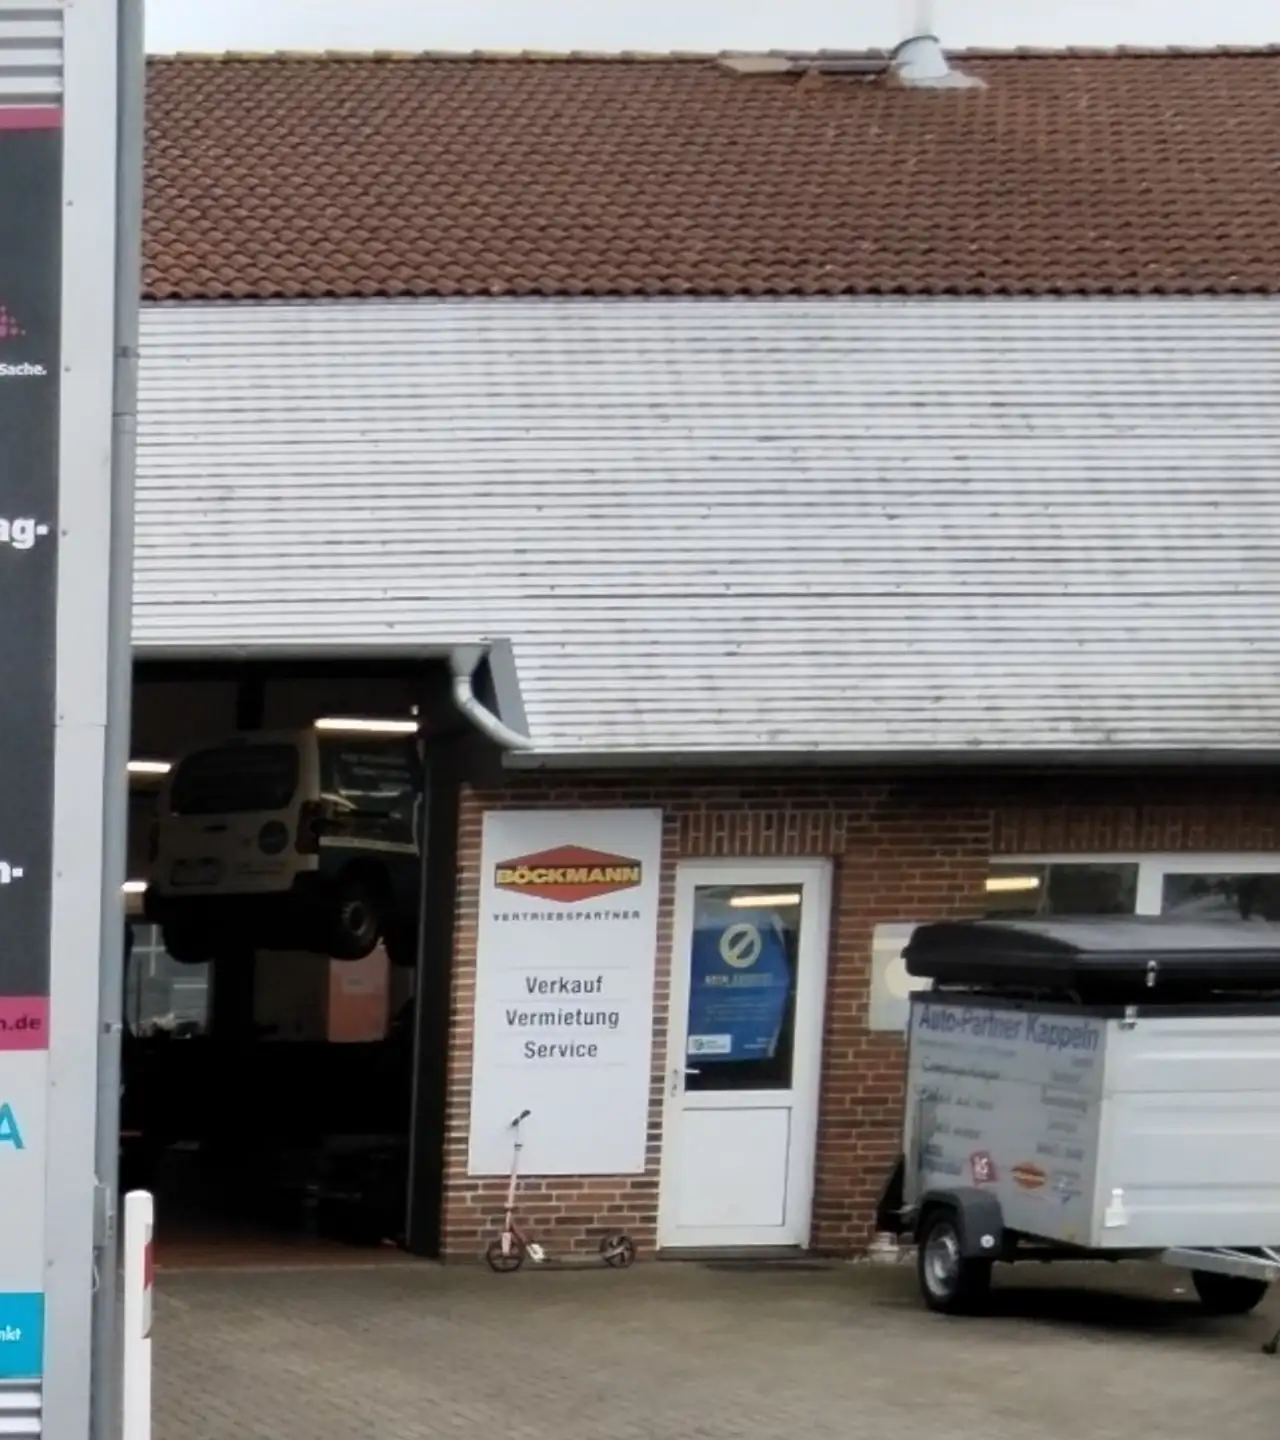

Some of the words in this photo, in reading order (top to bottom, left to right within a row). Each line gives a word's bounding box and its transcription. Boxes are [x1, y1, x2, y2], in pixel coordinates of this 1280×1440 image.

[496, 865, 639, 884] BÖCKMANN
[493, 910, 640, 921] VERTRIEBSPARTNER
[525, 976, 603, 994] Verkauf
[506, 1009, 620, 1029] Vermietung
[1026, 1013, 1100, 1052] Kappeln
[524, 1041, 598, 1058] Service
